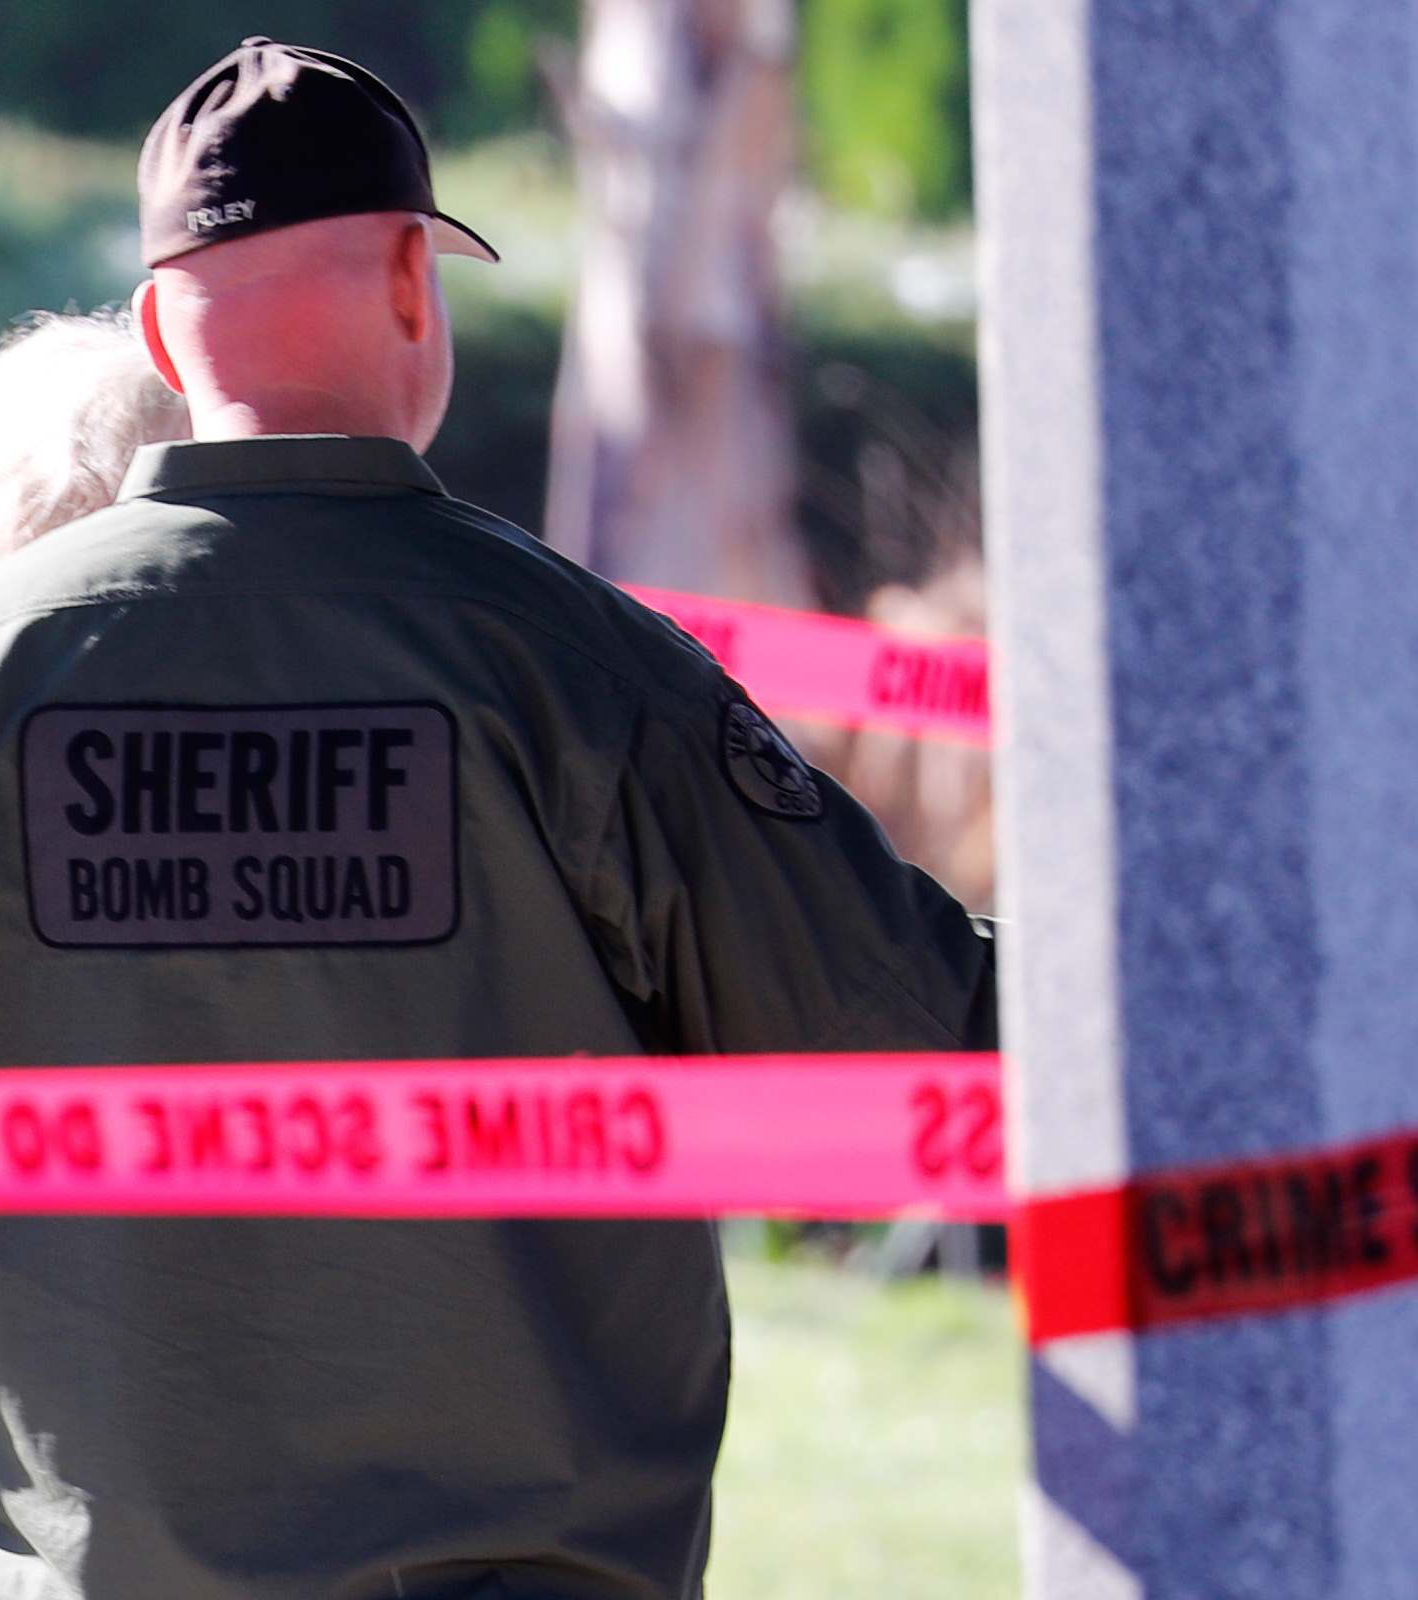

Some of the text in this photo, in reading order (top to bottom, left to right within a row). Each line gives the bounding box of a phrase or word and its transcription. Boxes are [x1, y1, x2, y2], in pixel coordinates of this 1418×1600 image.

[65, 729, 414, 836] SHERIFF
[68, 855, 411, 923] BOMB SQUAD
[1143, 1155, 1388, 1298] CRIME
